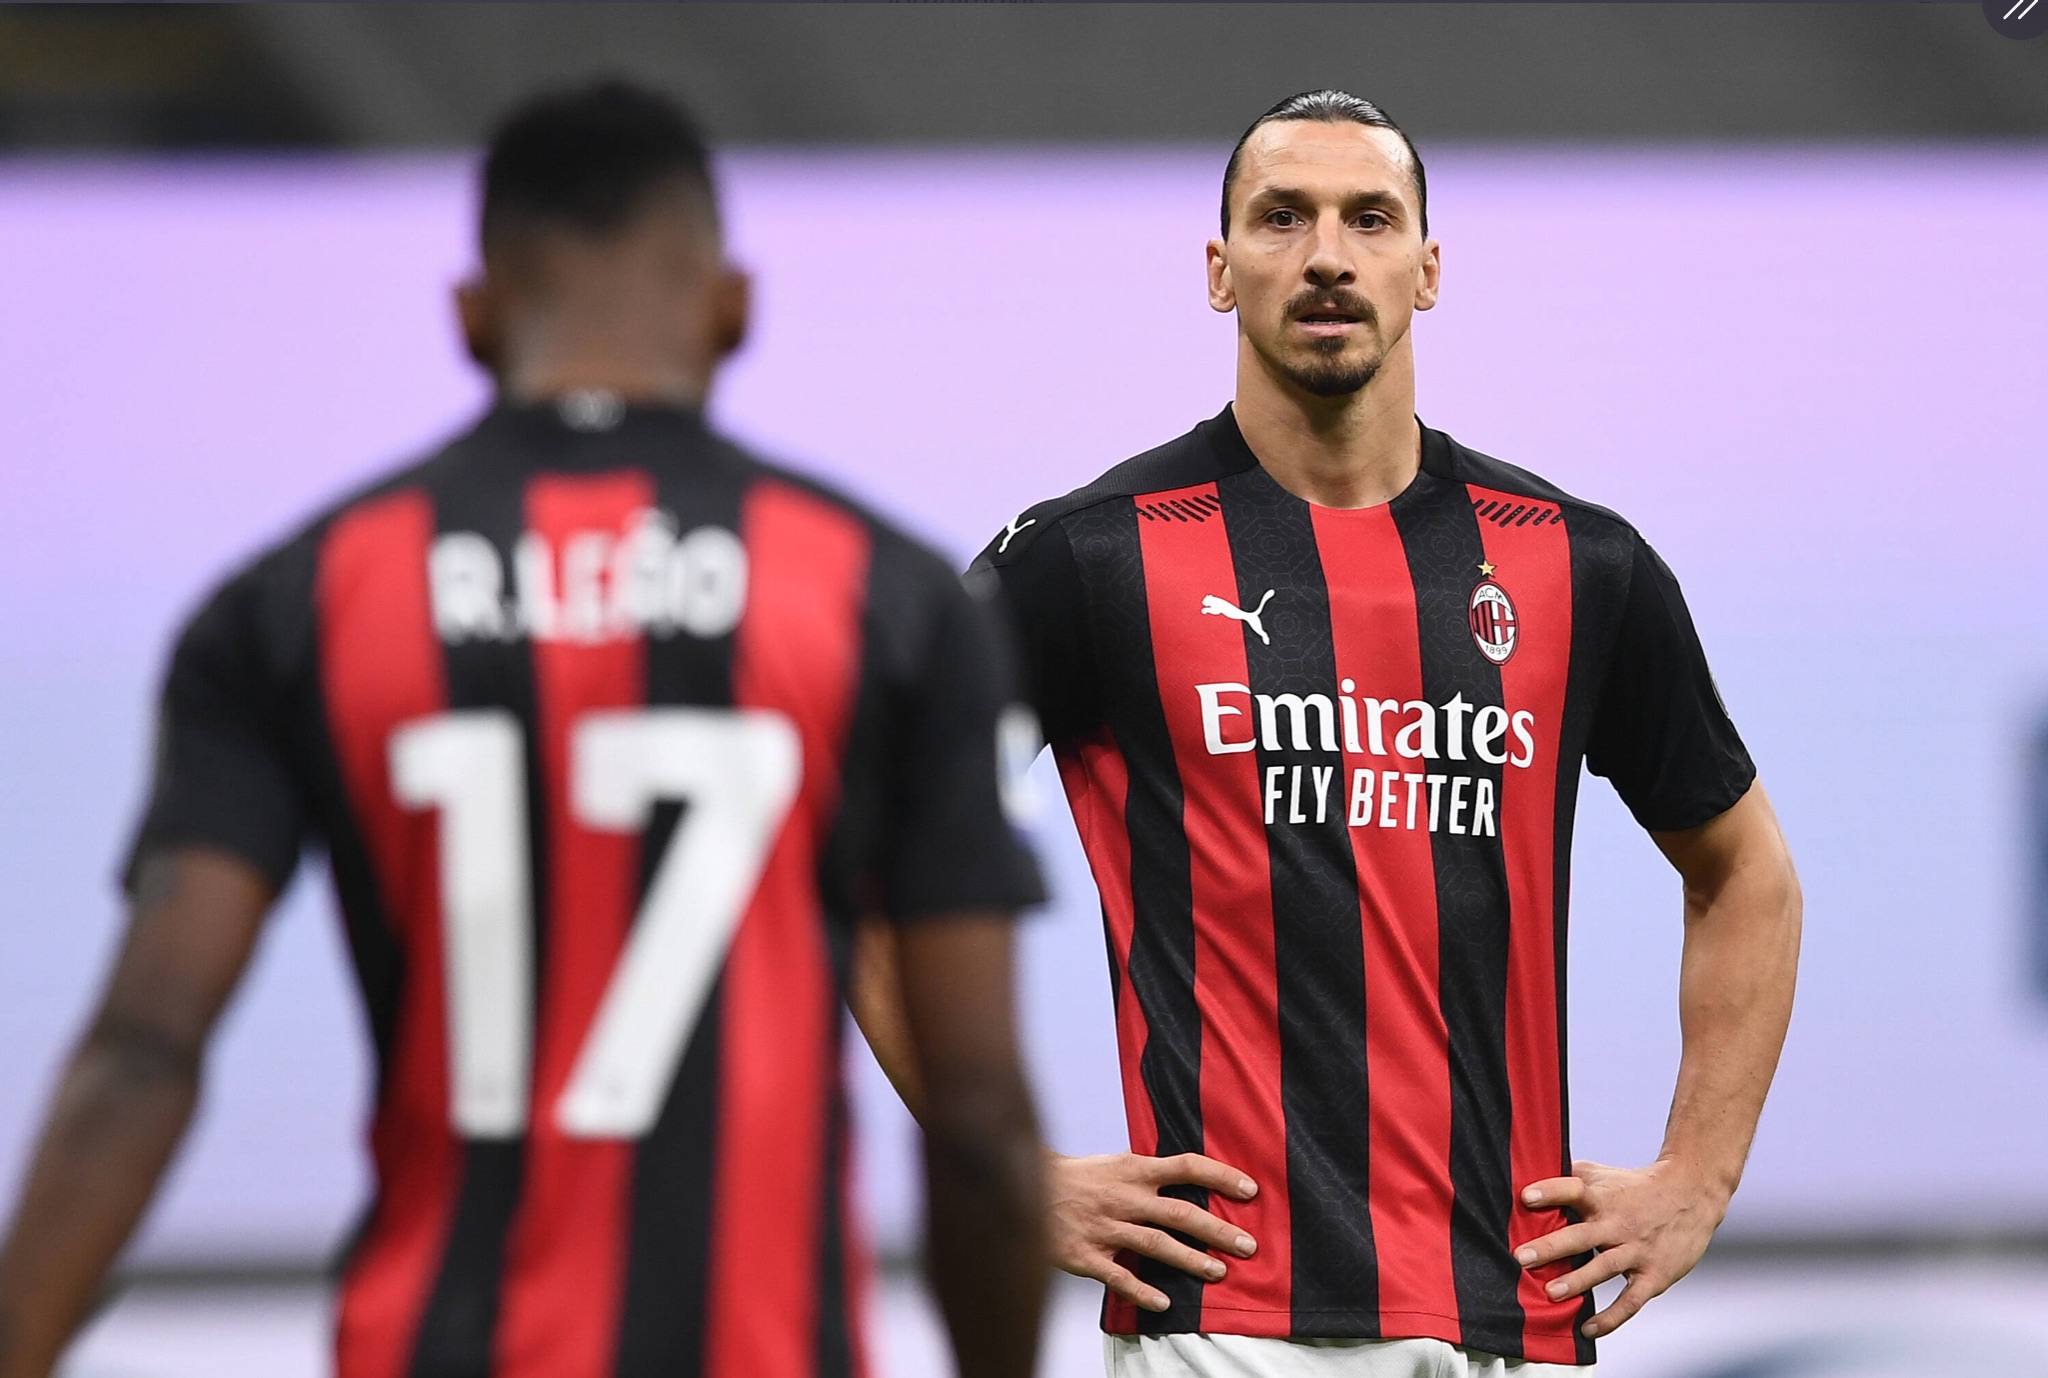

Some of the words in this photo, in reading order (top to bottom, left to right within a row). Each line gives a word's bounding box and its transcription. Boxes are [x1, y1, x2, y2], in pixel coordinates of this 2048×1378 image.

[1477, 587, 1505, 603] ACM
[1485, 645, 1508, 655] 1899
[1194, 678, 1535, 769] Emirates
[1263, 765, 1334, 826] FLY
[1348, 767, 1497, 837] BETTER
[386, 708, 804, 1138] 17
